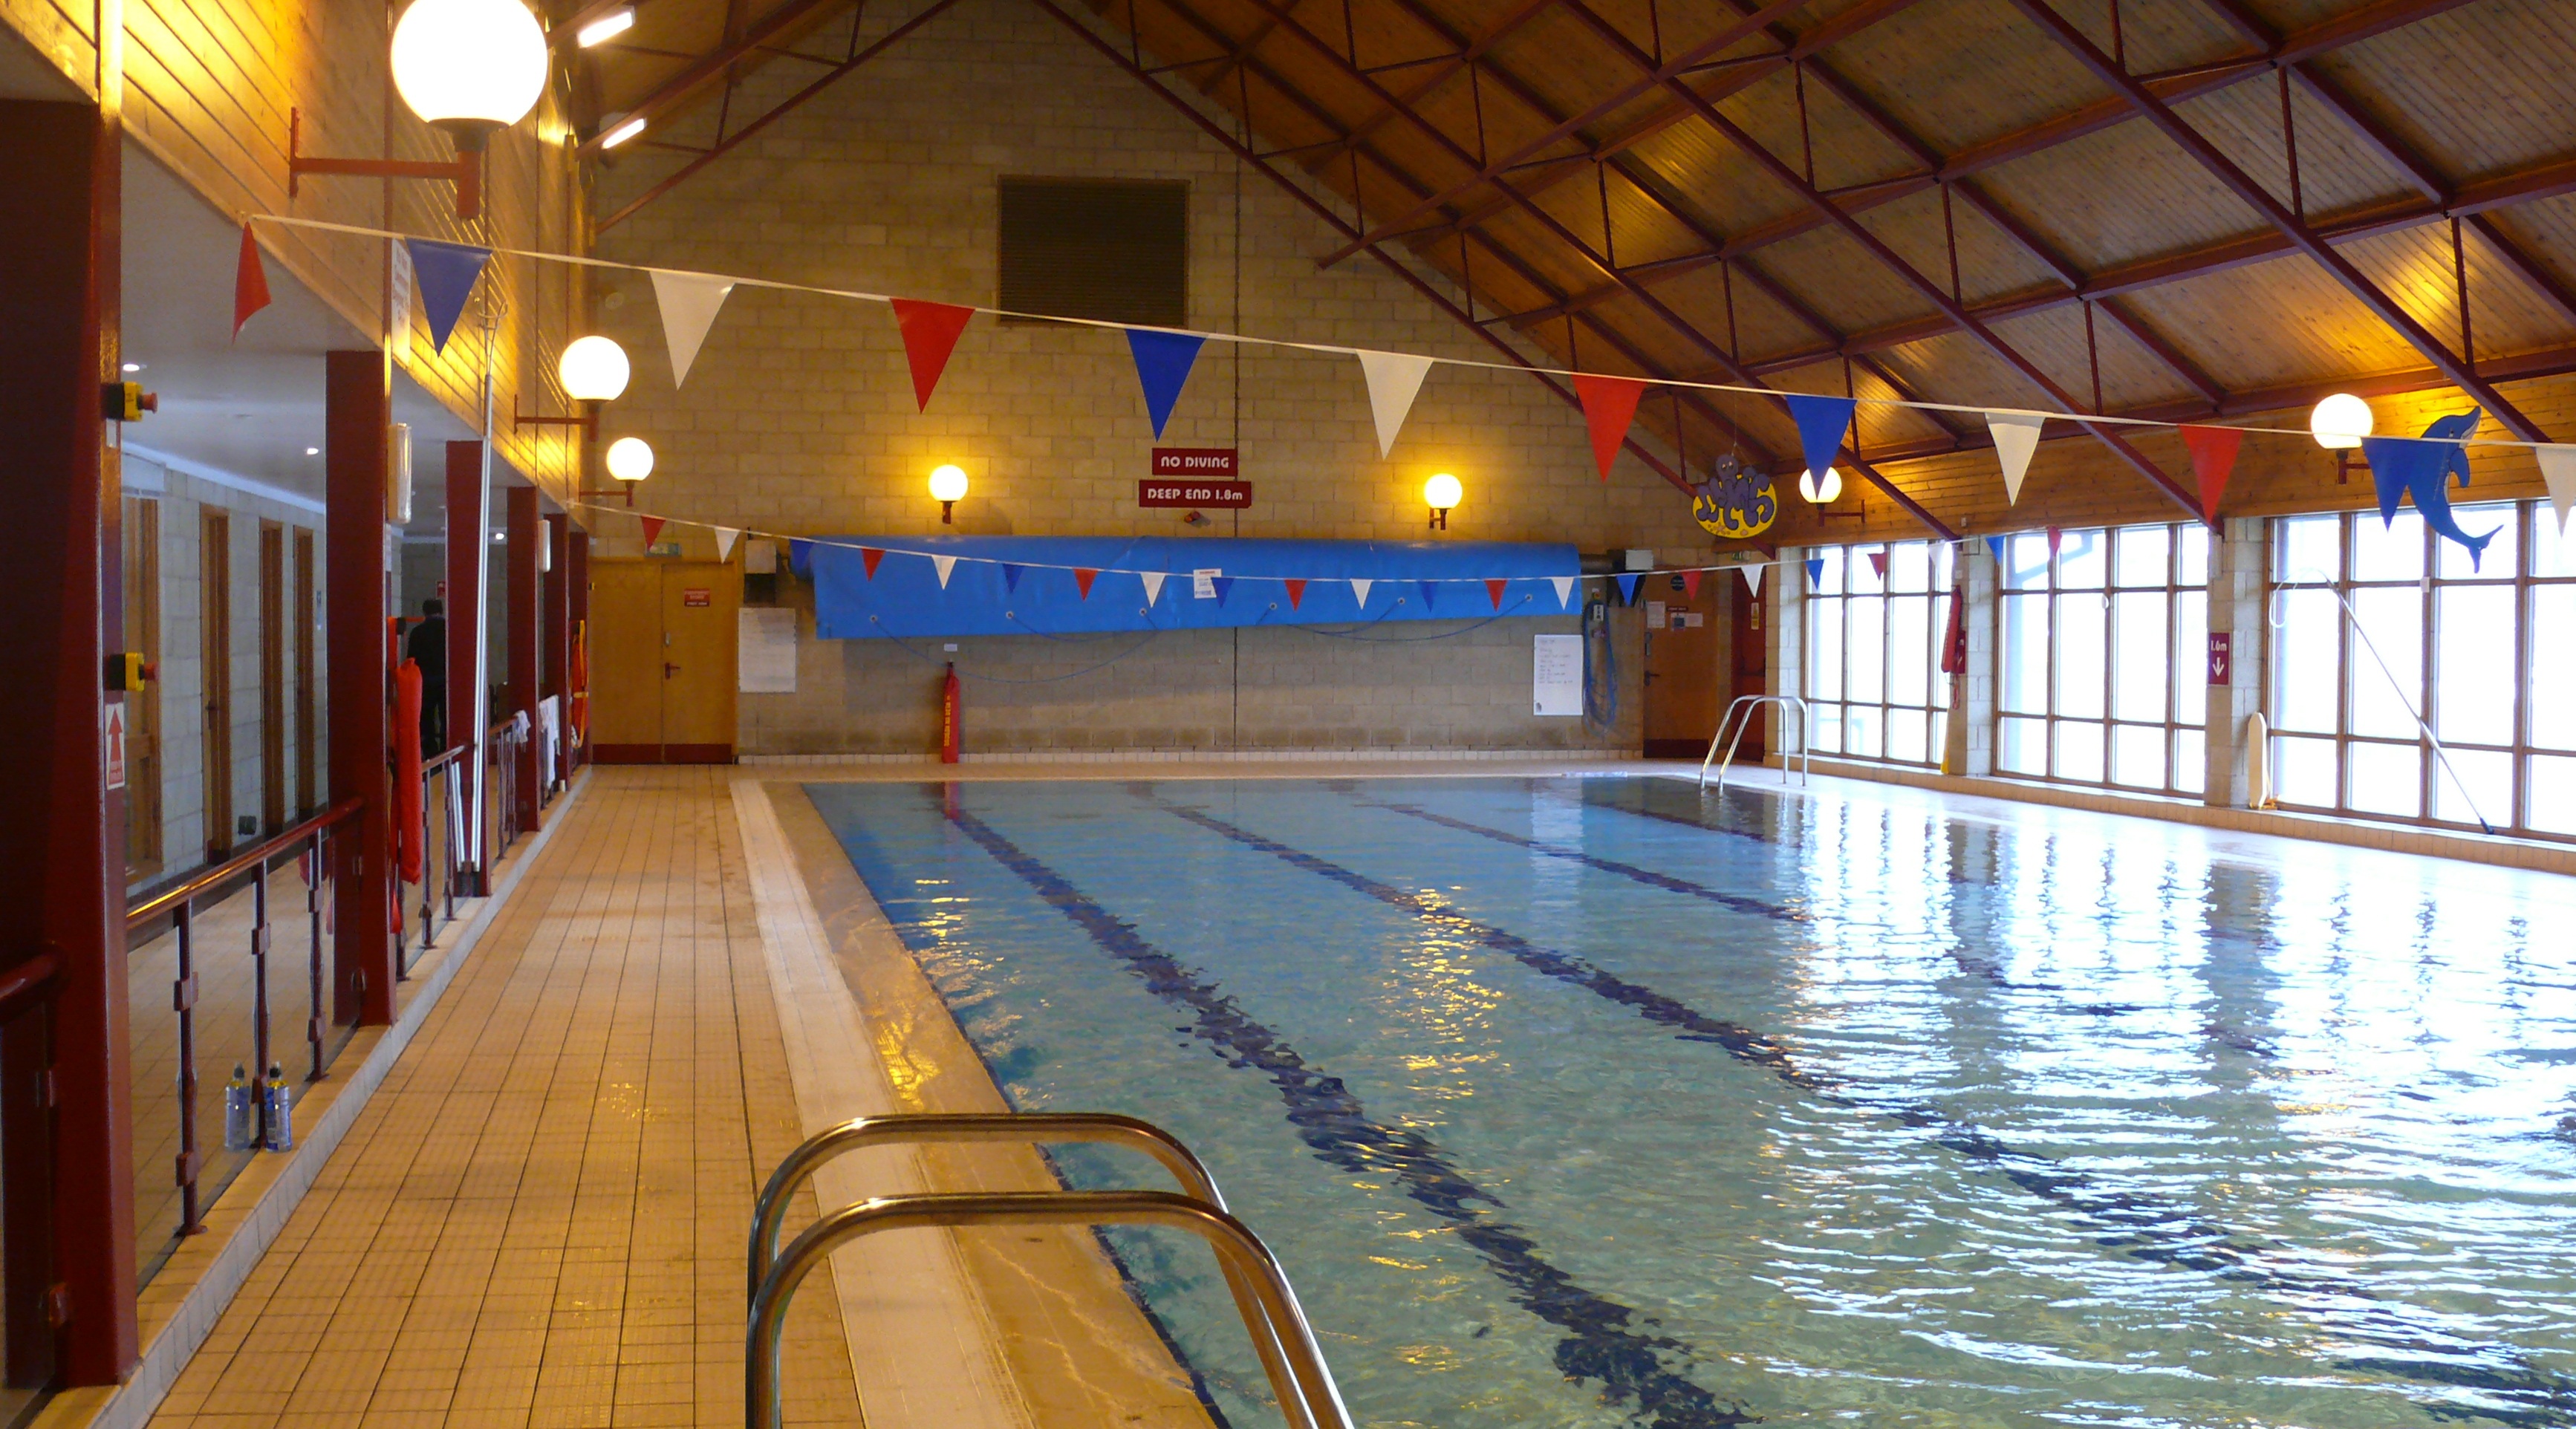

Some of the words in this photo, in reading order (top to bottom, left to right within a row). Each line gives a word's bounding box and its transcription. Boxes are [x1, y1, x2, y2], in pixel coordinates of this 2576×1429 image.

[1160, 456, 1181, 468] NO
[1185, 456, 1229, 469] DIVING
[1147, 488, 1181, 499] DEEP
[1185, 489, 1211, 500] END
[1215, 489, 1243, 501] 1.8m
